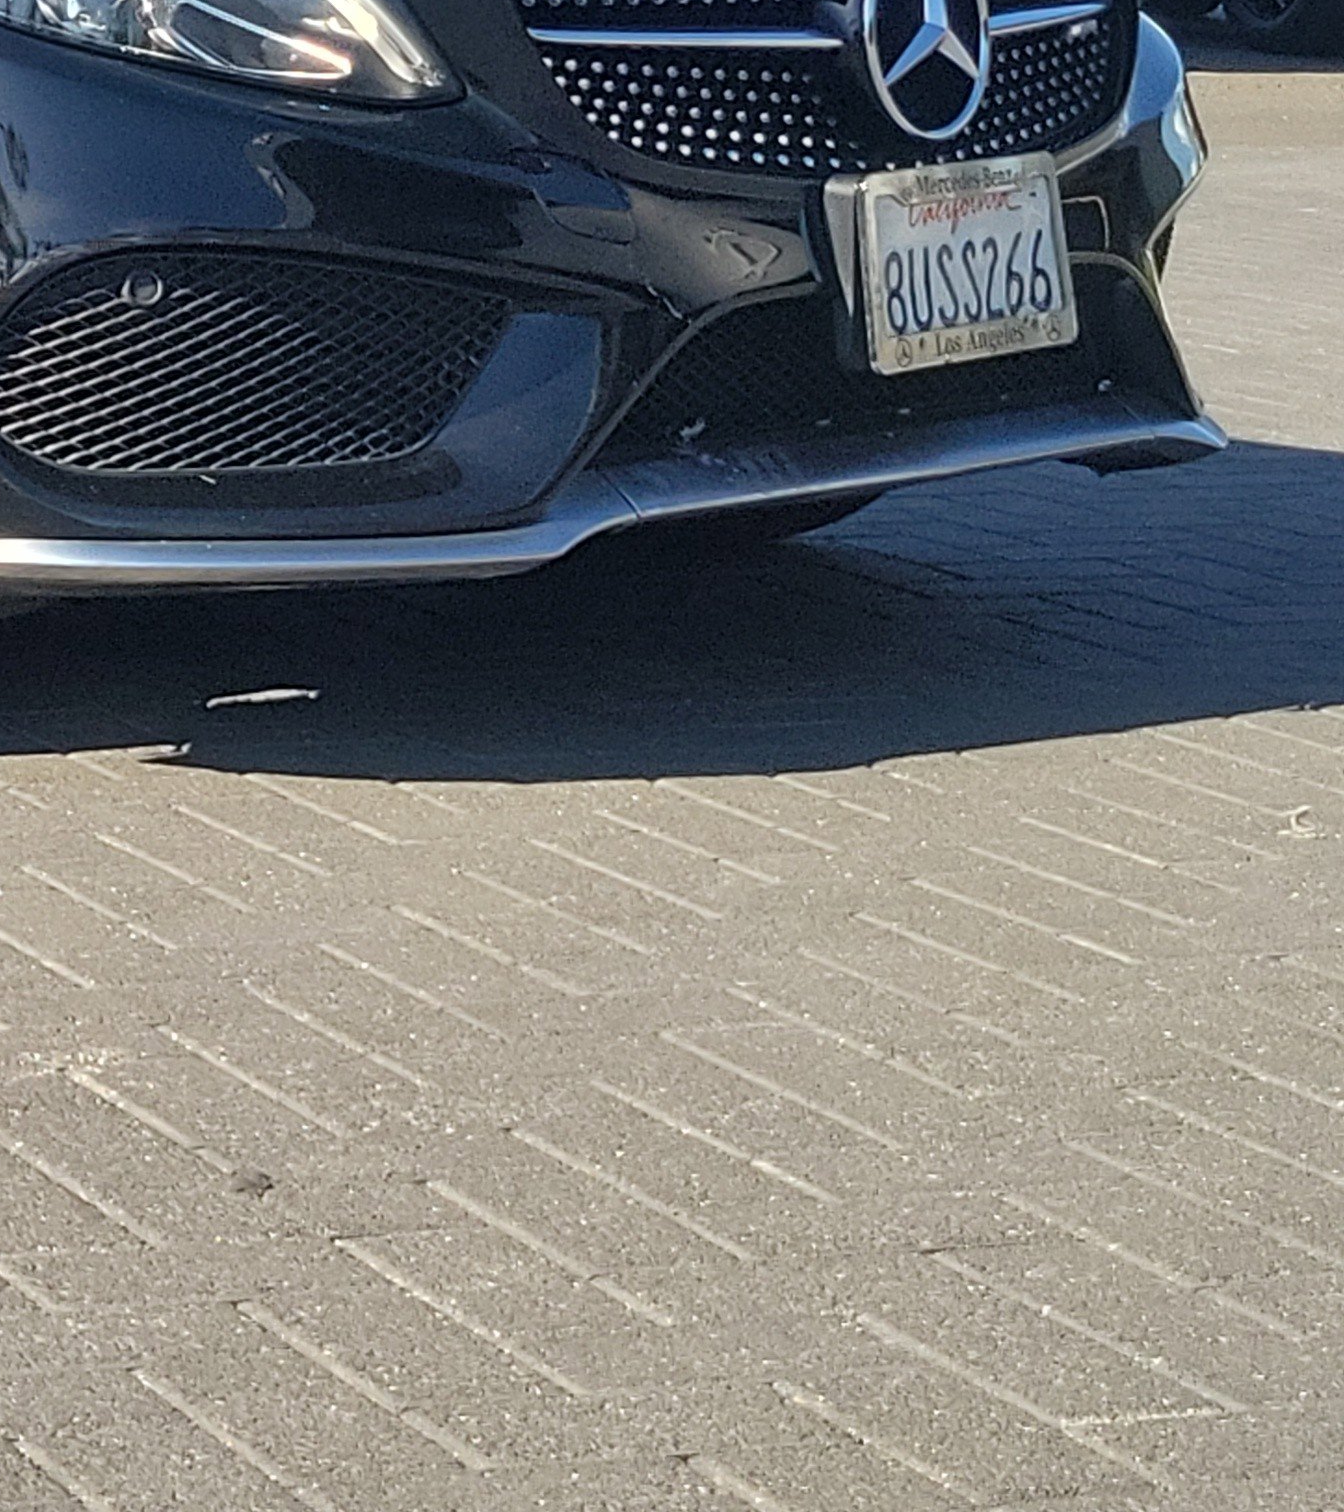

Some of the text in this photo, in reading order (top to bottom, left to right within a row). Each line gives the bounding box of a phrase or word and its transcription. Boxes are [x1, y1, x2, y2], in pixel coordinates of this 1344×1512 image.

[884, 228, 1053, 336] 8USS266
[935, 322, 1025, 357] Los Angeles
